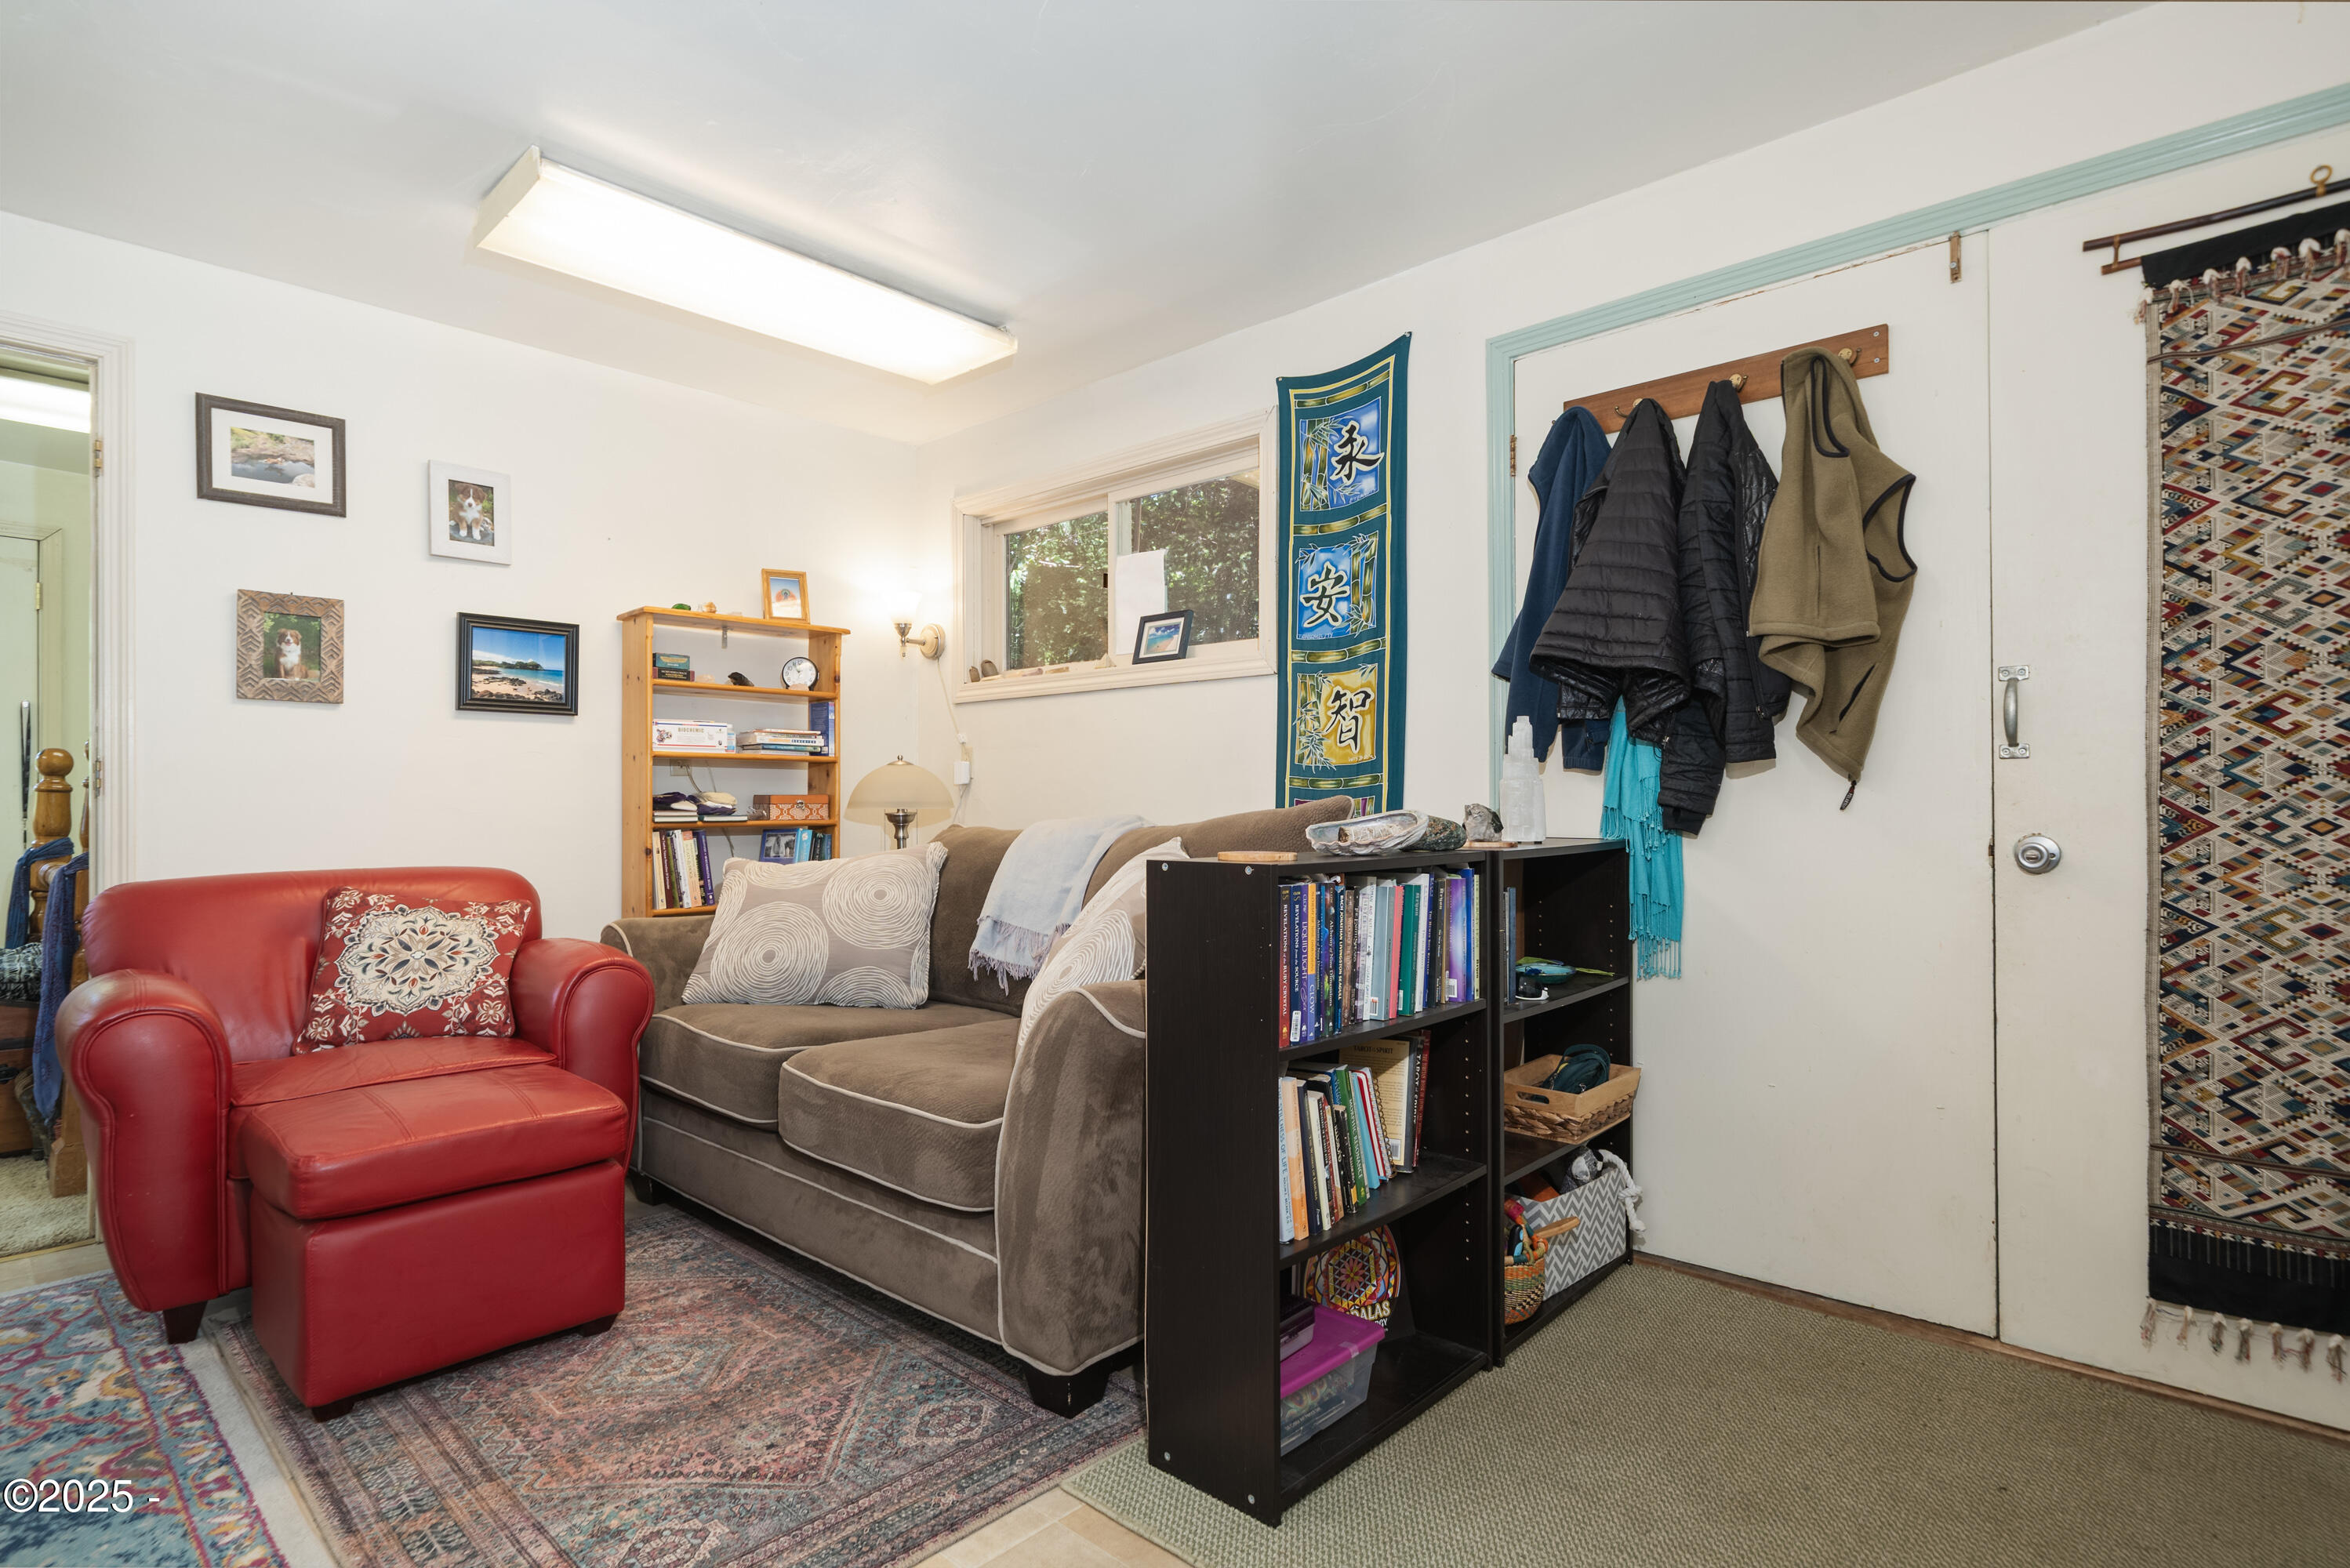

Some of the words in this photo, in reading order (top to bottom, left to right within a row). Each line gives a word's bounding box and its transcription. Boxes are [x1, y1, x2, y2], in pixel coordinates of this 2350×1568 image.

[1335, 423, 1383, 481] 永
[1302, 564, 1349, 626] 安
[1324, 690, 1372, 751] 智
[1281, 1145, 1286, 1154] OF
[1353, 1135, 1363, 1179] RESONANCE
